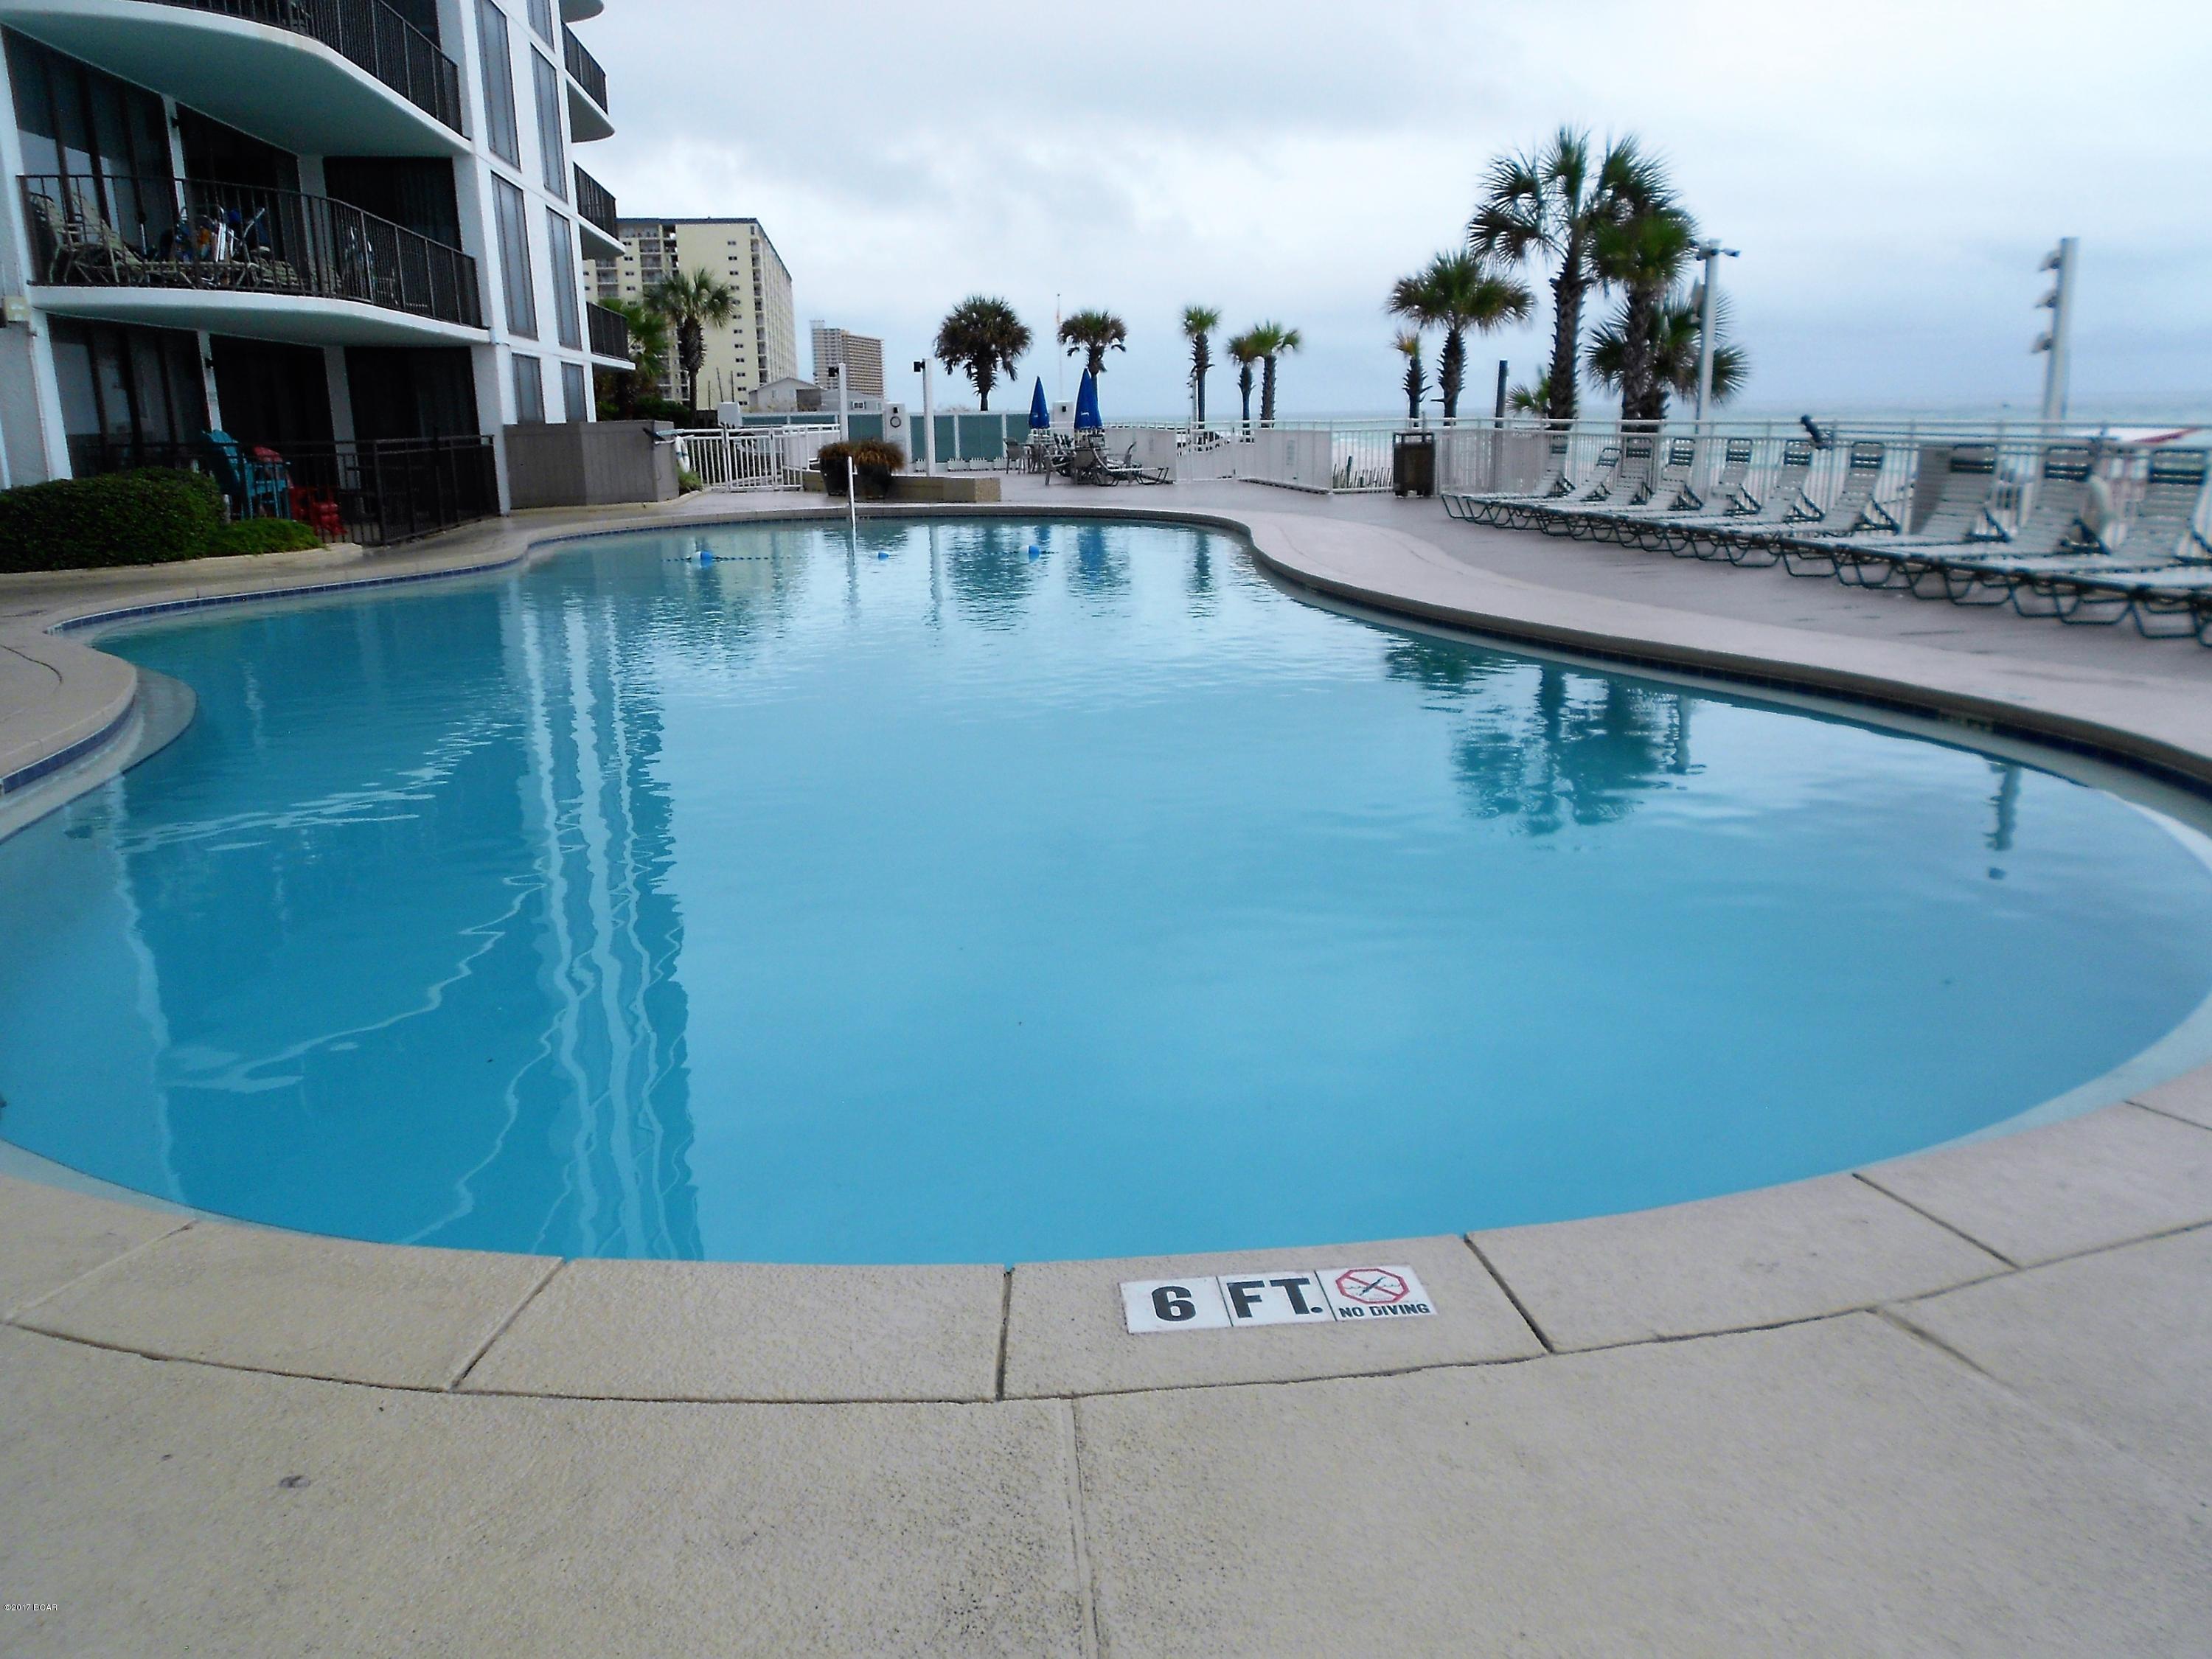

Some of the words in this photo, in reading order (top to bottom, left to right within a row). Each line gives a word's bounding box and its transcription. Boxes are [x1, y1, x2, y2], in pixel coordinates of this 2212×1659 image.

[1152, 1285, 1196, 1322] 6
[1227, 1277, 1324, 1318] FT.
[1339, 1307, 1365, 1318] NO
[1369, 1304, 1430, 1316] DIVING
